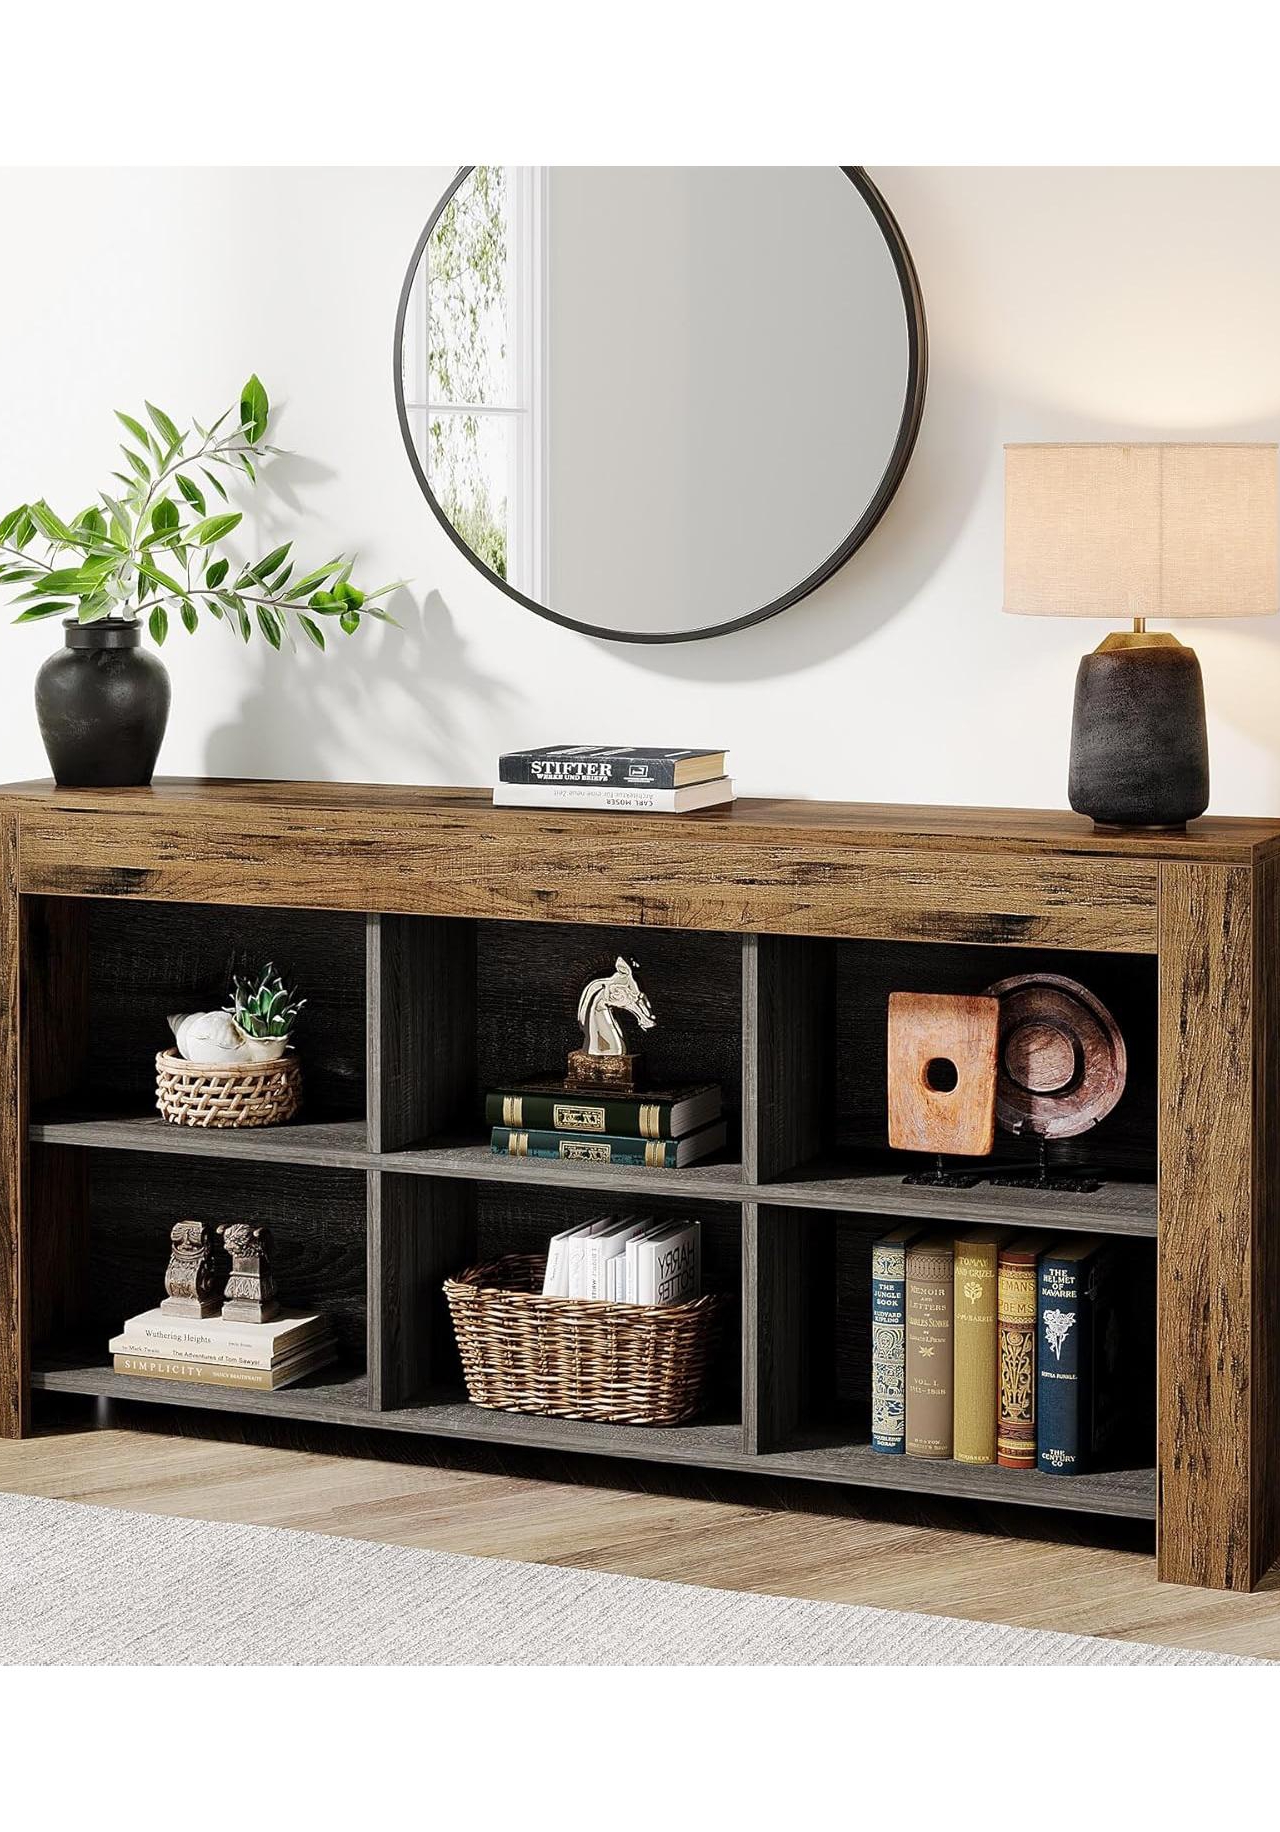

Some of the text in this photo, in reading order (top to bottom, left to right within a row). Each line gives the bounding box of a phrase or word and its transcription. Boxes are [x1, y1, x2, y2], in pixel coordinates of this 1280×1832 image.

[531, 760, 612, 777] STIFTER
[606, 798, 654, 807] CARL MOSER
[958, 1256, 989, 1267] TOMMY
[1048, 1268, 1068, 1277] THE
[1042, 1274, 1076, 1285] HELMET
[878, 1283, 895, 1291] THE
[910, 1285, 946, 1296] MEMOIR
[873, 1290, 901, 1299] JUNGLE
[1041, 1288, 1078, 1299] NAVARRE
[876, 1298, 899, 1306] BOOK
[909, 1300, 947, 1311] LETTERS
[998, 1300, 1035, 1314] POEMS
[145, 1329, 212, 1344] Wuthering Heights
[184, 1351, 217, 1361] Adventures
[124, 1359, 203, 1377] SIMPLICITY
[1041, 1452, 1076, 1463] CENTURY
